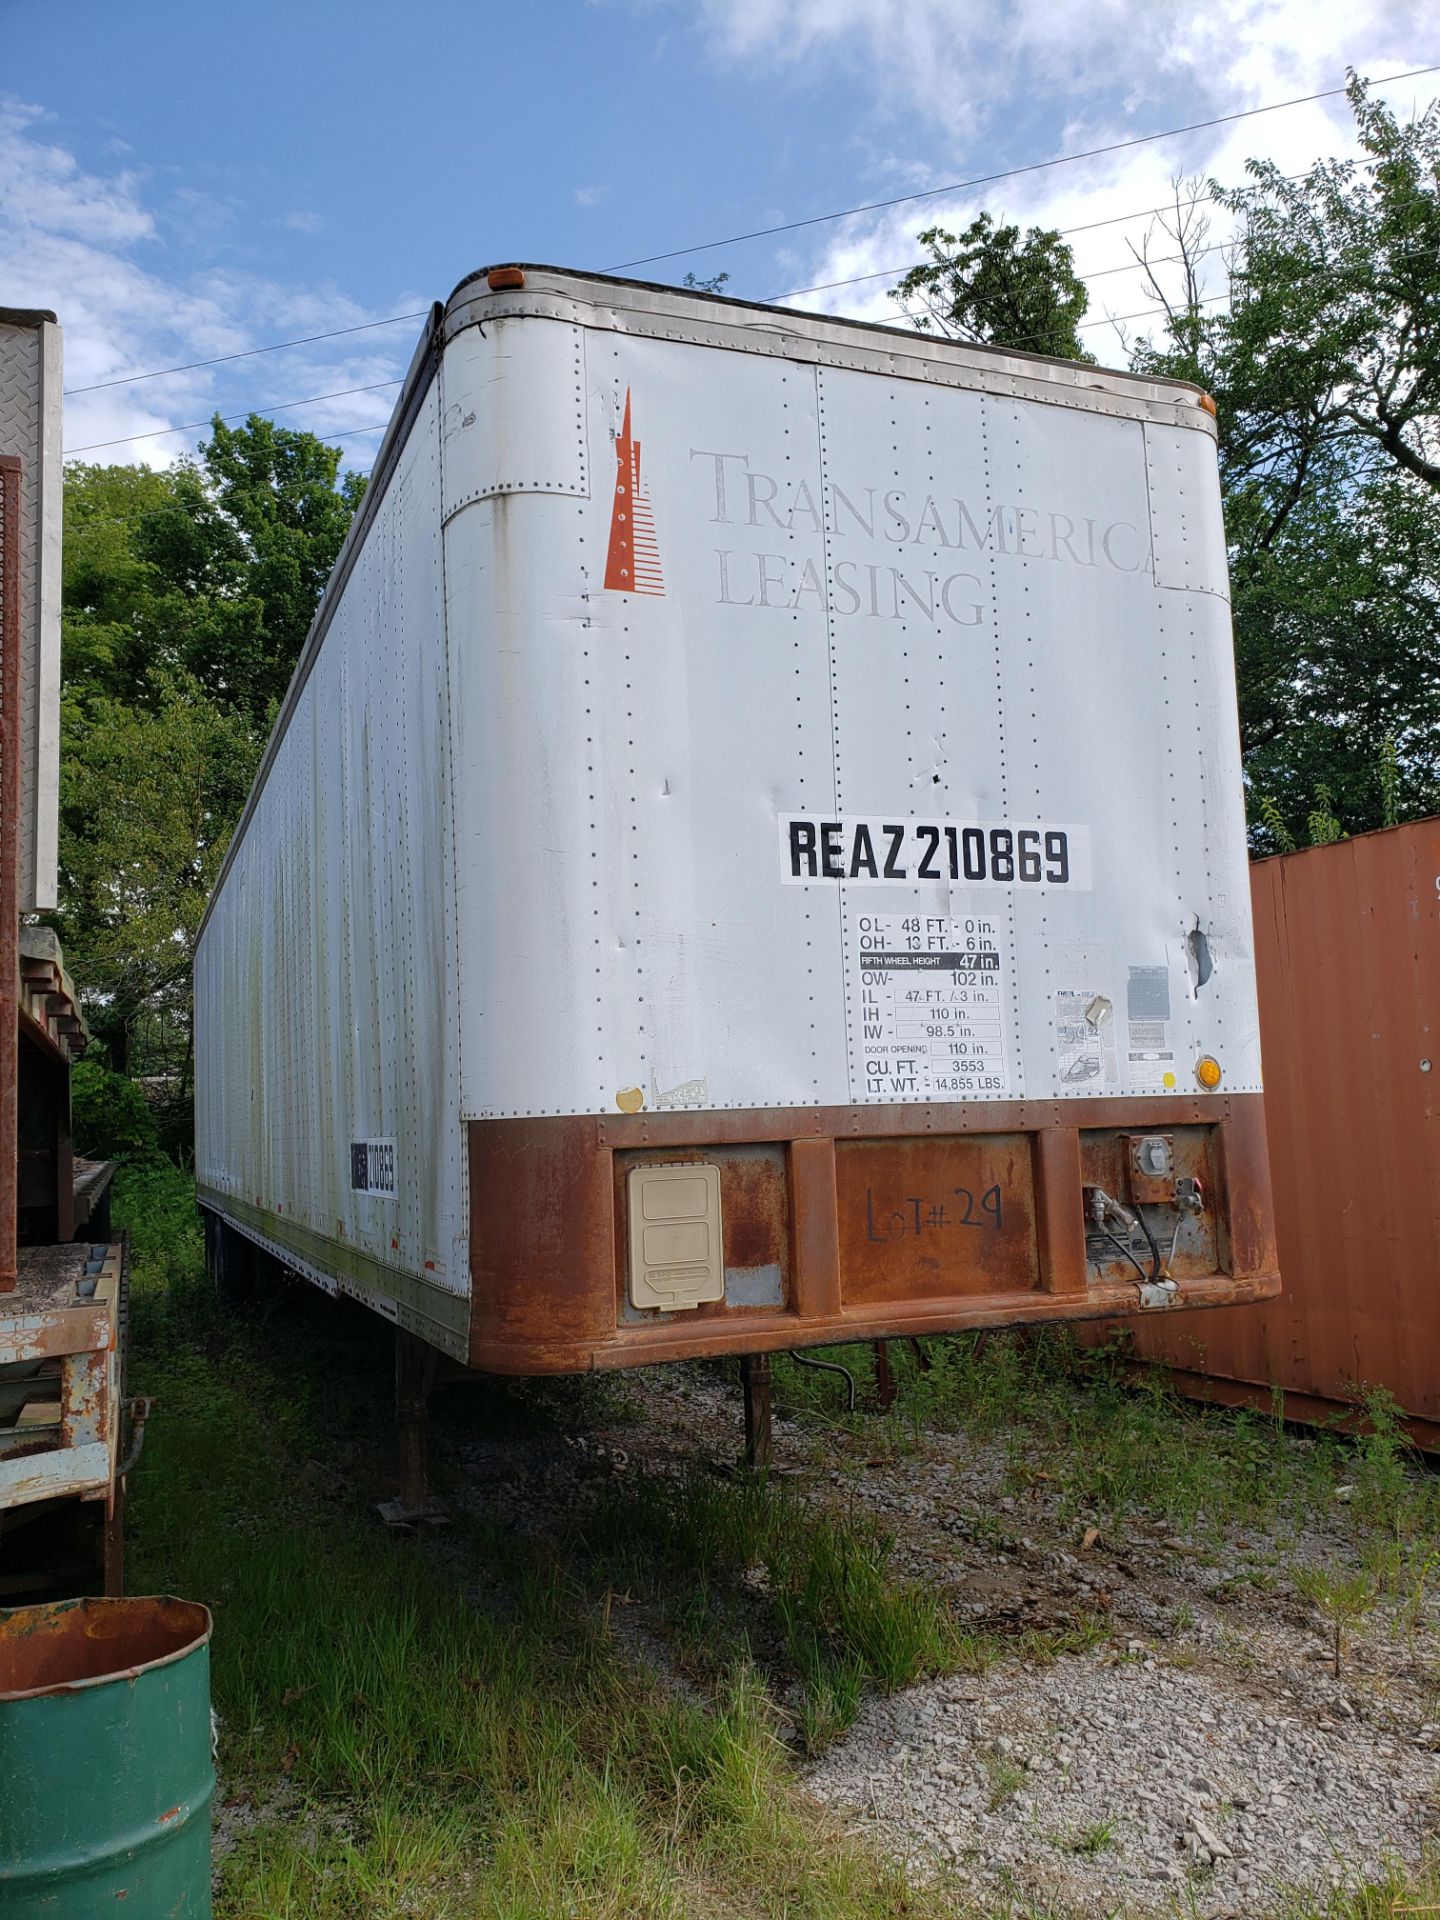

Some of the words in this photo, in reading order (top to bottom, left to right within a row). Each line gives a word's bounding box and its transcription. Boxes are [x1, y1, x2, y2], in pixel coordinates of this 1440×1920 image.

[713, 549, 985, 627] LEASING
[901, 918, 921, 933] 48
[926, 919, 948, 933] FT.
[965, 919, 975, 934] 0
[978, 919, 995, 934] in.
[905, 936, 921, 950] 13
[927, 936, 949, 950] FT.
[966, 936, 976, 951] 6
[978, 937, 996, 951] in.
[861, 956, 883, 965] FIFTH
[884, 956, 912, 965] WHEEL
[912, 956, 941, 965] HEIGHT
[959, 954, 978, 969] 47
[980, 954, 999, 969] in.
[951, 971, 977, 986] 102
[980, 972, 998, 986] in.
[862, 989, 878, 1004] IL
[905, 990, 920, 1002] 47
[925, 990, 945, 1002] FT.
[960, 990, 968, 1002] 3
[973, 990, 989, 1002] in.
[863, 1007, 880, 1022] IH
[930, 1008, 949, 1020] 110
[954, 1008, 970, 1020] in.
[863, 1024, 883, 1039] IW
[926, 1025, 955, 1037] 98.5
[960, 1025, 975, 1037] in.
[864, 1045, 889, 1054] DOOR
[890, 1045, 927, 1054] OPENING
[948, 1043, 967, 1054] 110
[972, 1043, 988, 1054] in.
[866, 1060, 892, 1075] CU.
[896, 1060, 919, 1074] FT.
[952, 1061, 985, 1072] 3553
[867, 1079, 887, 1093] LT.
[890, 1078, 920, 1092] WT.
[978, 1077, 1004, 1089] LBS.
